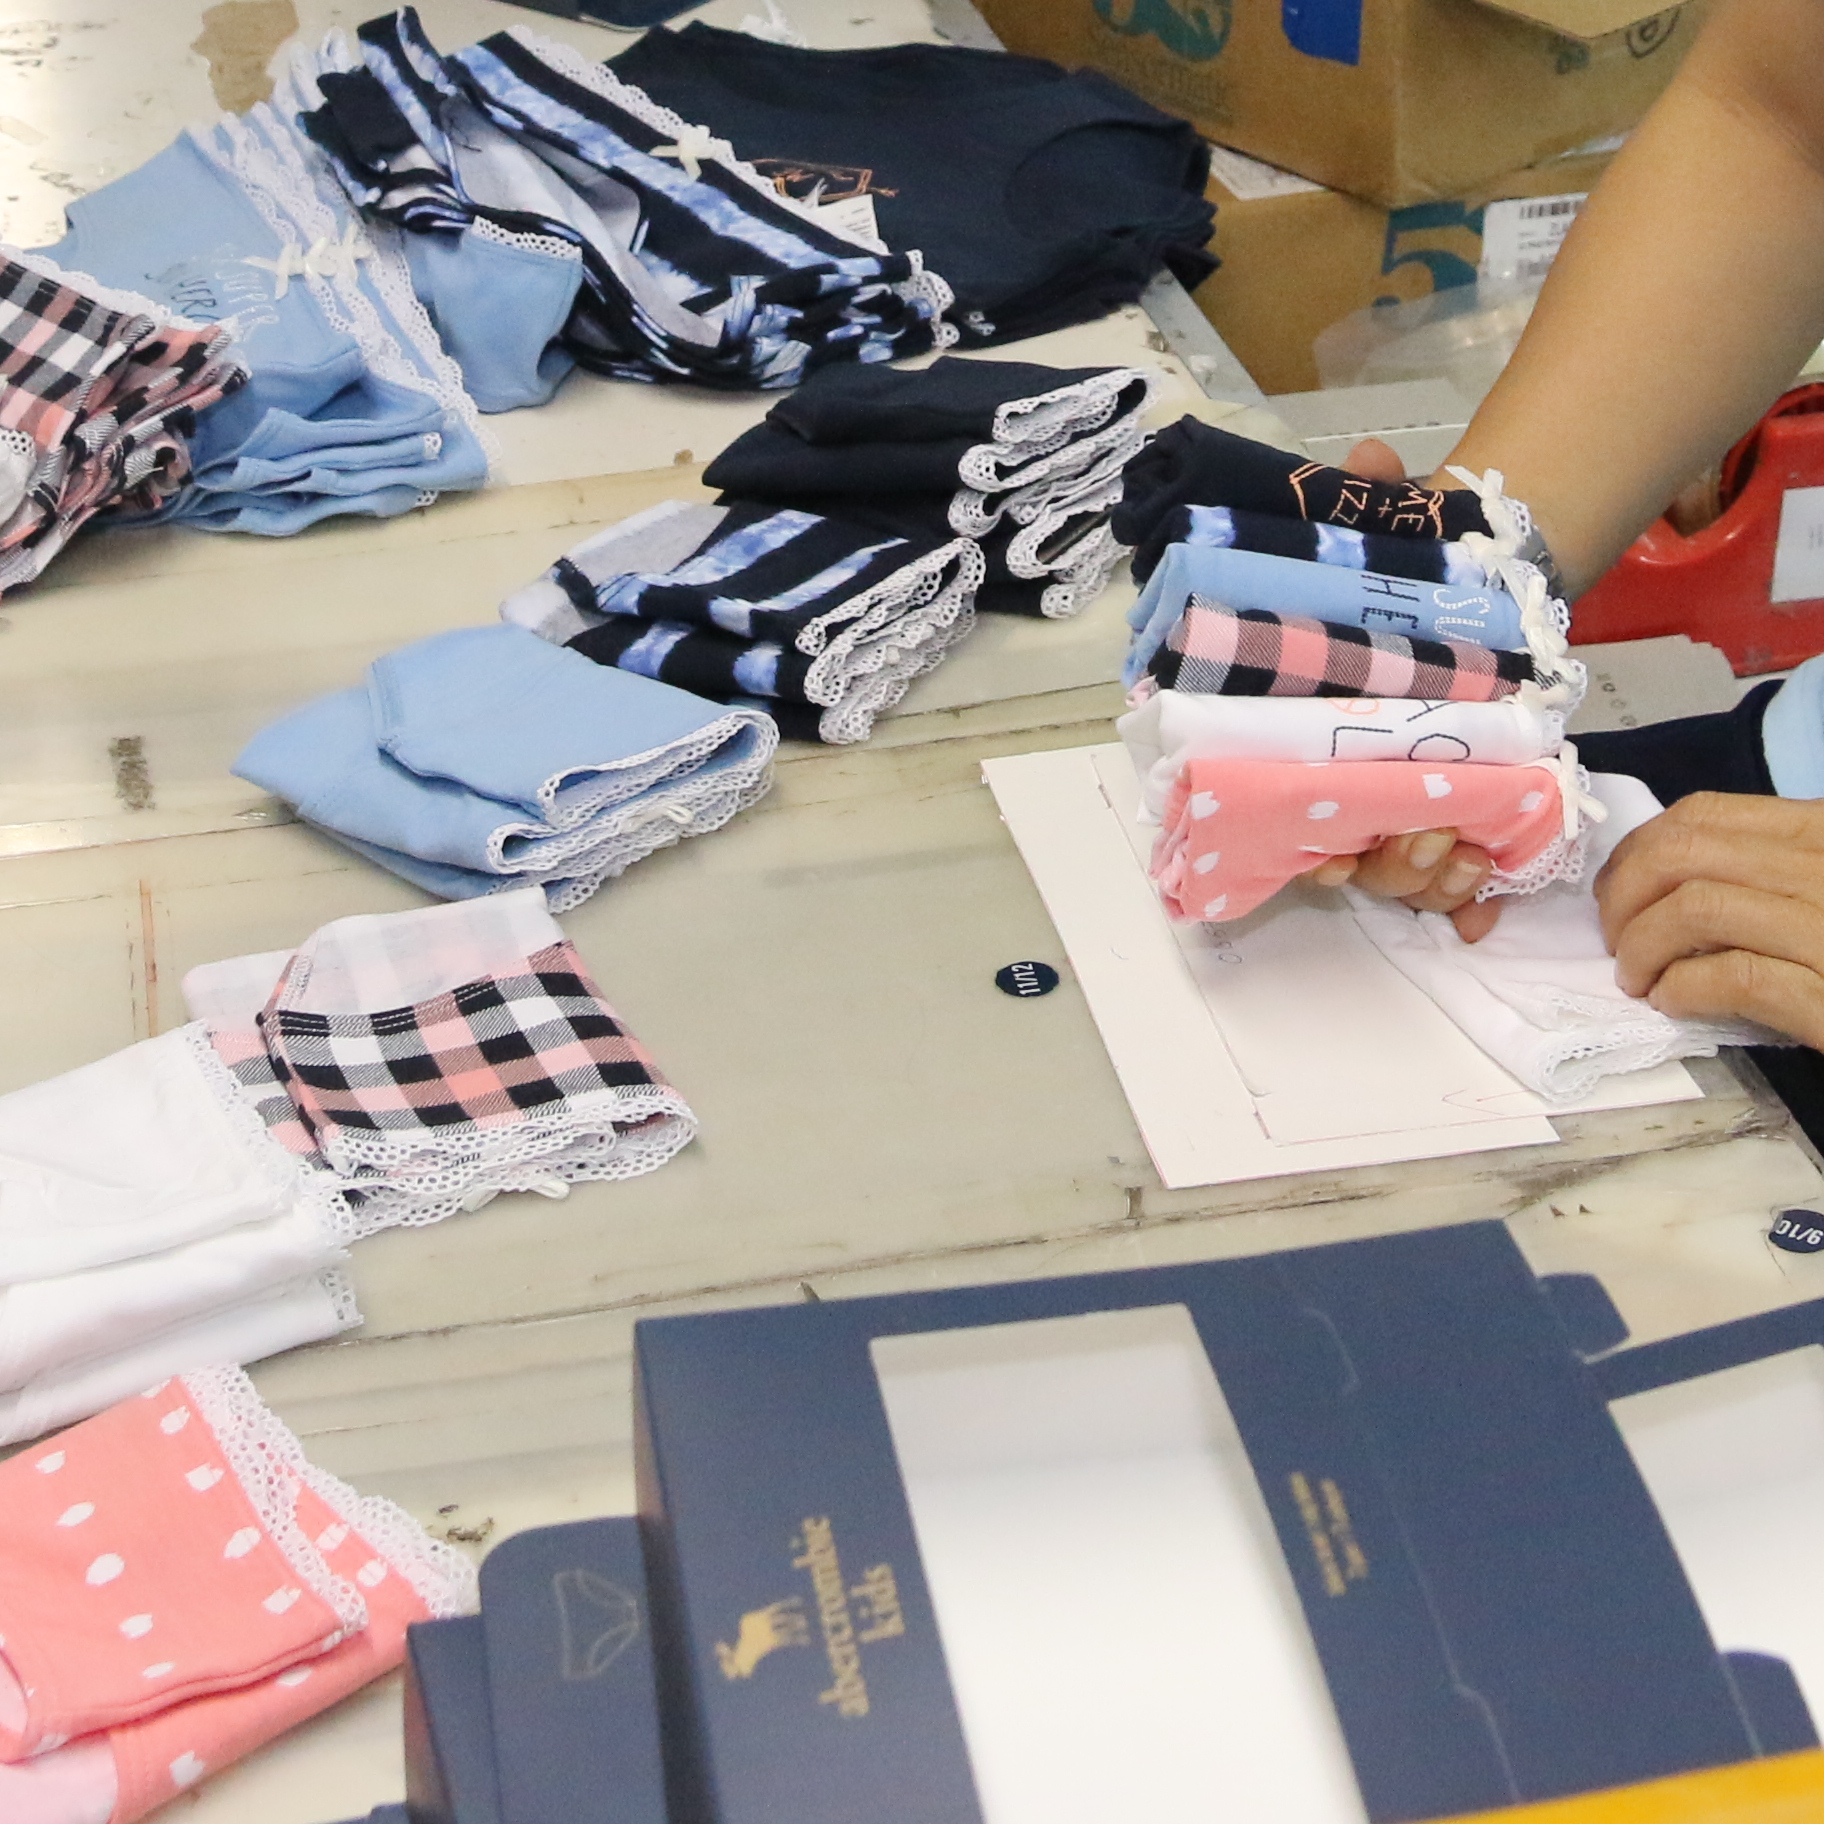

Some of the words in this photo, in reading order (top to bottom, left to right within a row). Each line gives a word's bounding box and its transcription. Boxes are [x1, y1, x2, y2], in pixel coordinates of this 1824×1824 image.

[1390, 482, 1429, 532] ME
[1010, 963, 1042, 996] 11/12
[787, 1515, 871, 1718] abercrombie
[847, 1561, 907, 1644] kids
